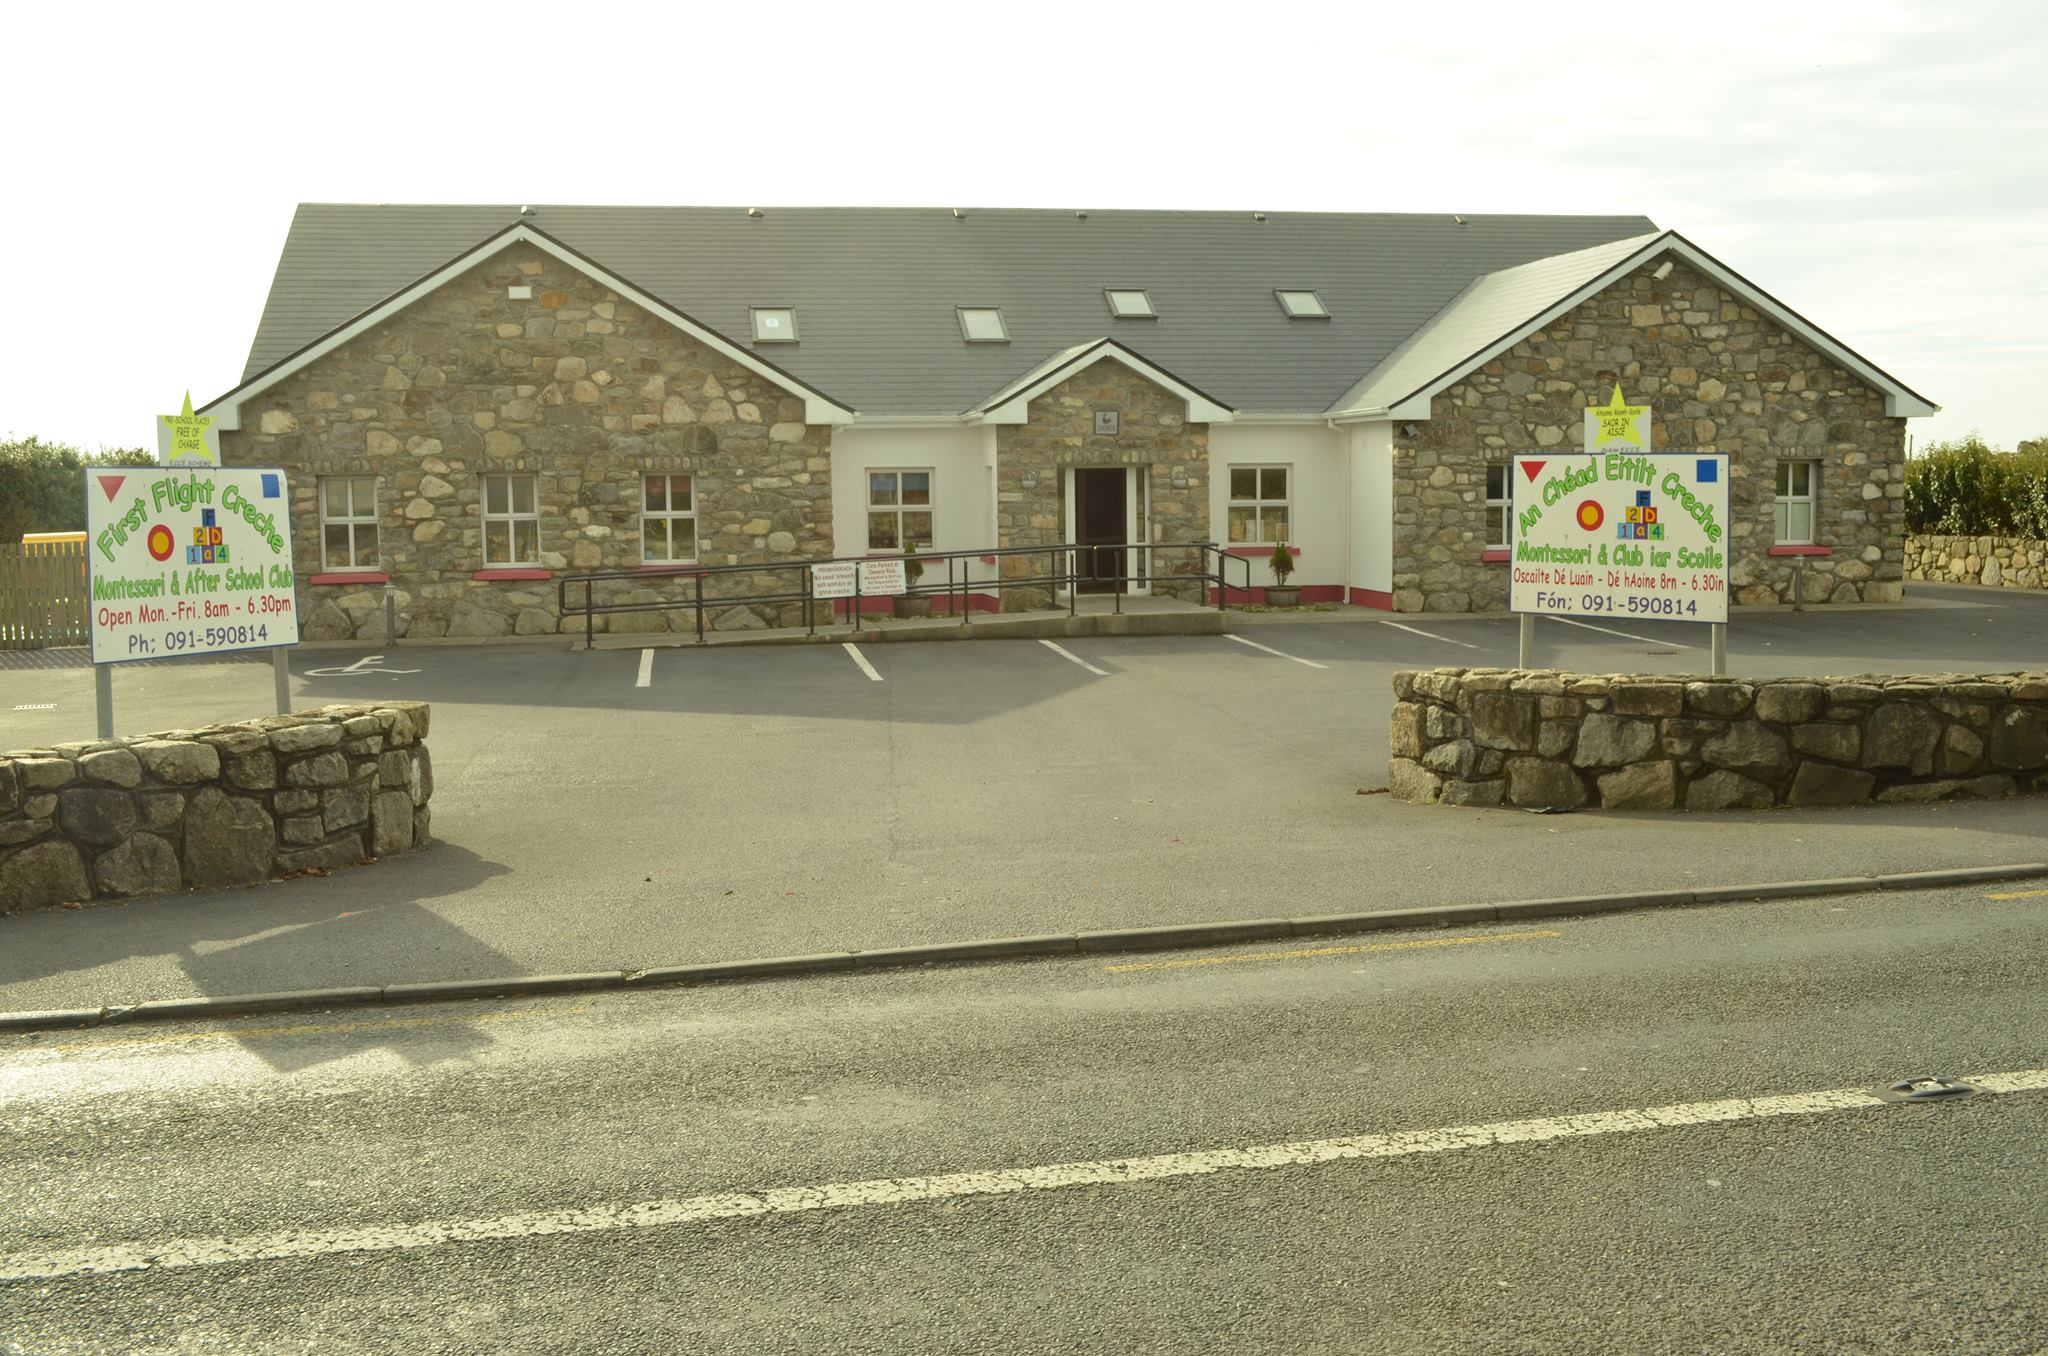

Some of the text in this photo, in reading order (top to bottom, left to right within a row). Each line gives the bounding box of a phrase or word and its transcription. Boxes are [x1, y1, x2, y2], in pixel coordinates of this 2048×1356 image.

[165, 416, 193, 425] PRE-SCHOOL
[176, 426, 200, 438] FREE OF
[1602, 417, 1630, 428] SAOR IN
[178, 439, 200, 450] CHARGE
[1519, 454, 1722, 543] An Chéad Eitilt Creche
[96, 473, 284, 563] First Flight Creche
[1516, 540, 1723, 569] Montessori & Club iar Scoile
[93, 564, 293, 601] Montessori & After School Club
[1513, 567, 1550, 584] Oscailte
[1554, 571, 1566, 585] Dé
[1569, 571, 1593, 586] Luain
[1607, 571, 1620, 588] Dé
[1624, 572, 1656, 589] hAoine
[1660, 573, 1677, 590] 8rn
[1691, 574, 1724, 592] 6.30in
[98, 607, 133, 631] Open
[204, 600, 230, 618] 8am
[247, 595, 291, 617] 6.30pm
[1581, 594, 1697, 615] 091-590814
[165, 624, 268, 650] 091-590814
